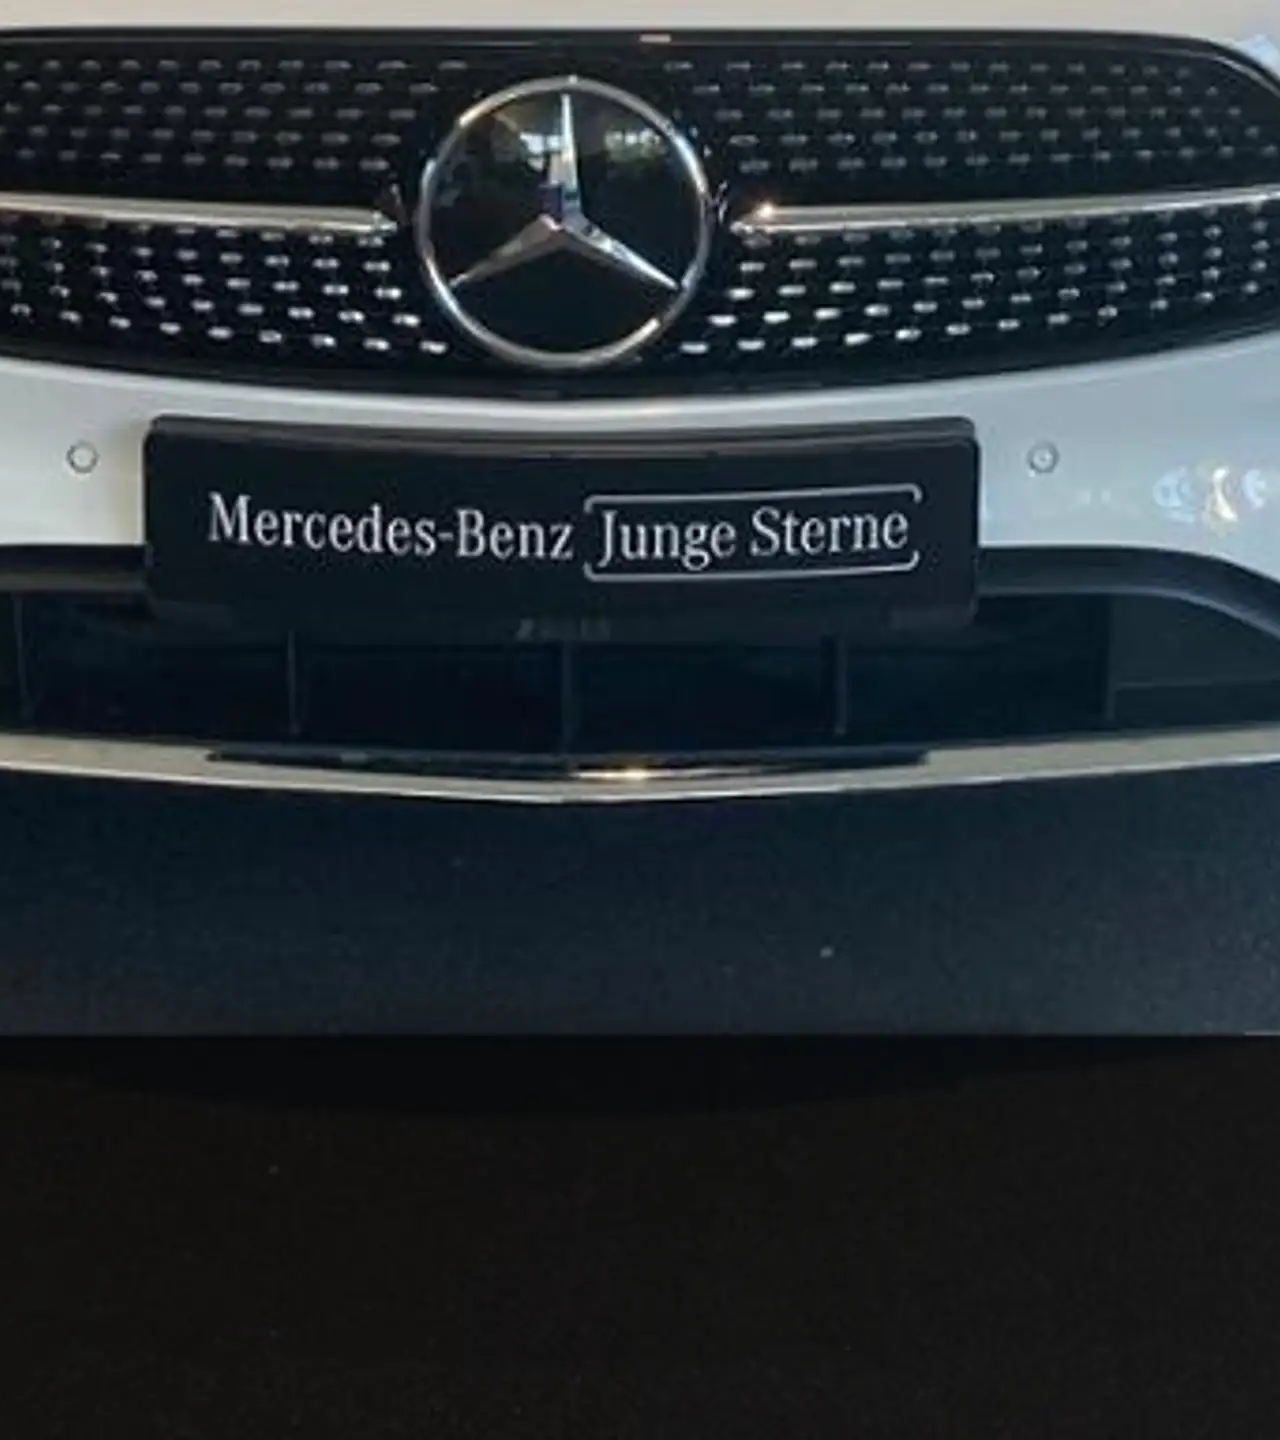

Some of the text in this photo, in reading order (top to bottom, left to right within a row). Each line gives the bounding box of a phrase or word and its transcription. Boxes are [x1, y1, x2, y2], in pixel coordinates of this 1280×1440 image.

[208, 491, 909, 571] Mercedes-Benz Junge Sterne
